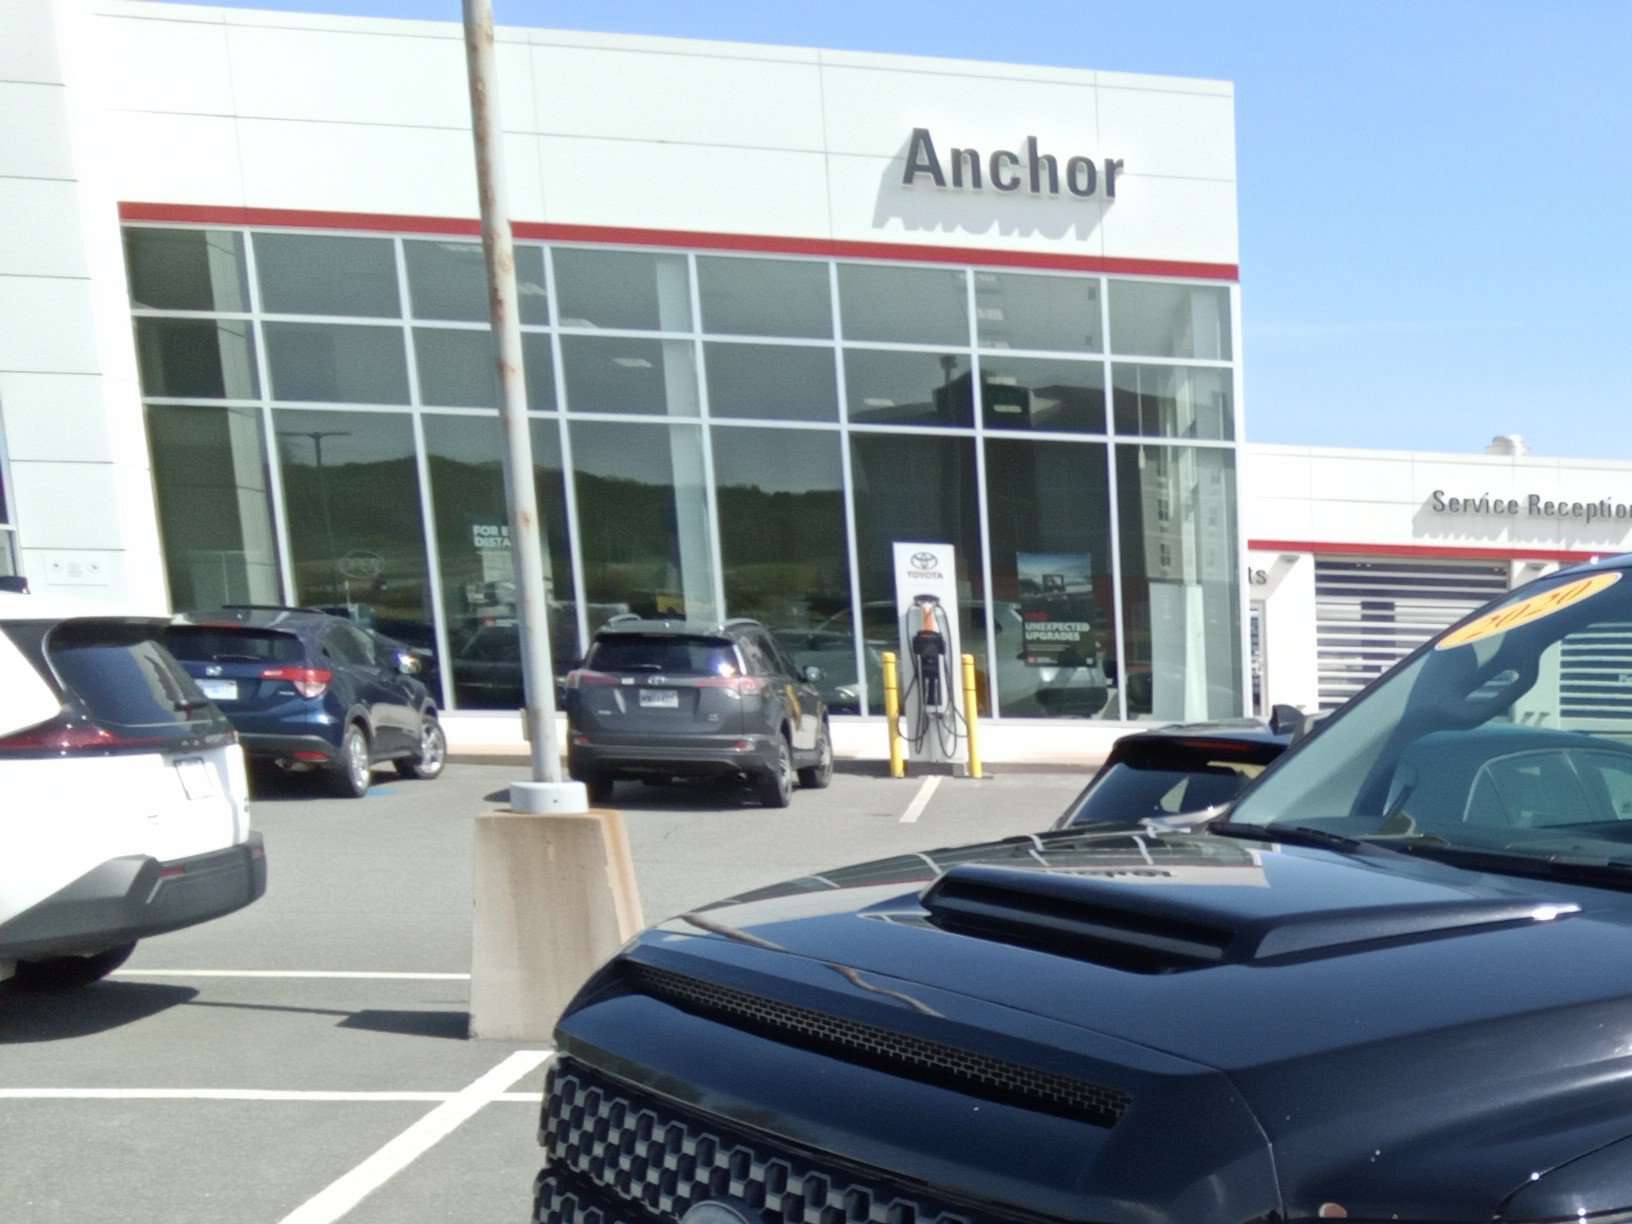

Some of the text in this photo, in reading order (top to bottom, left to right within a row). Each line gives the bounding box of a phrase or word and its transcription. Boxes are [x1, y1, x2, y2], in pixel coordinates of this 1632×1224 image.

[902, 127, 1125, 199] Anchor
[1432, 490, 1519, 515] Service
[474, 537, 512, 548] DISTA
[907, 571, 944, 579] TOYOTA
[1025, 632, 1080, 641] UPGRADES
